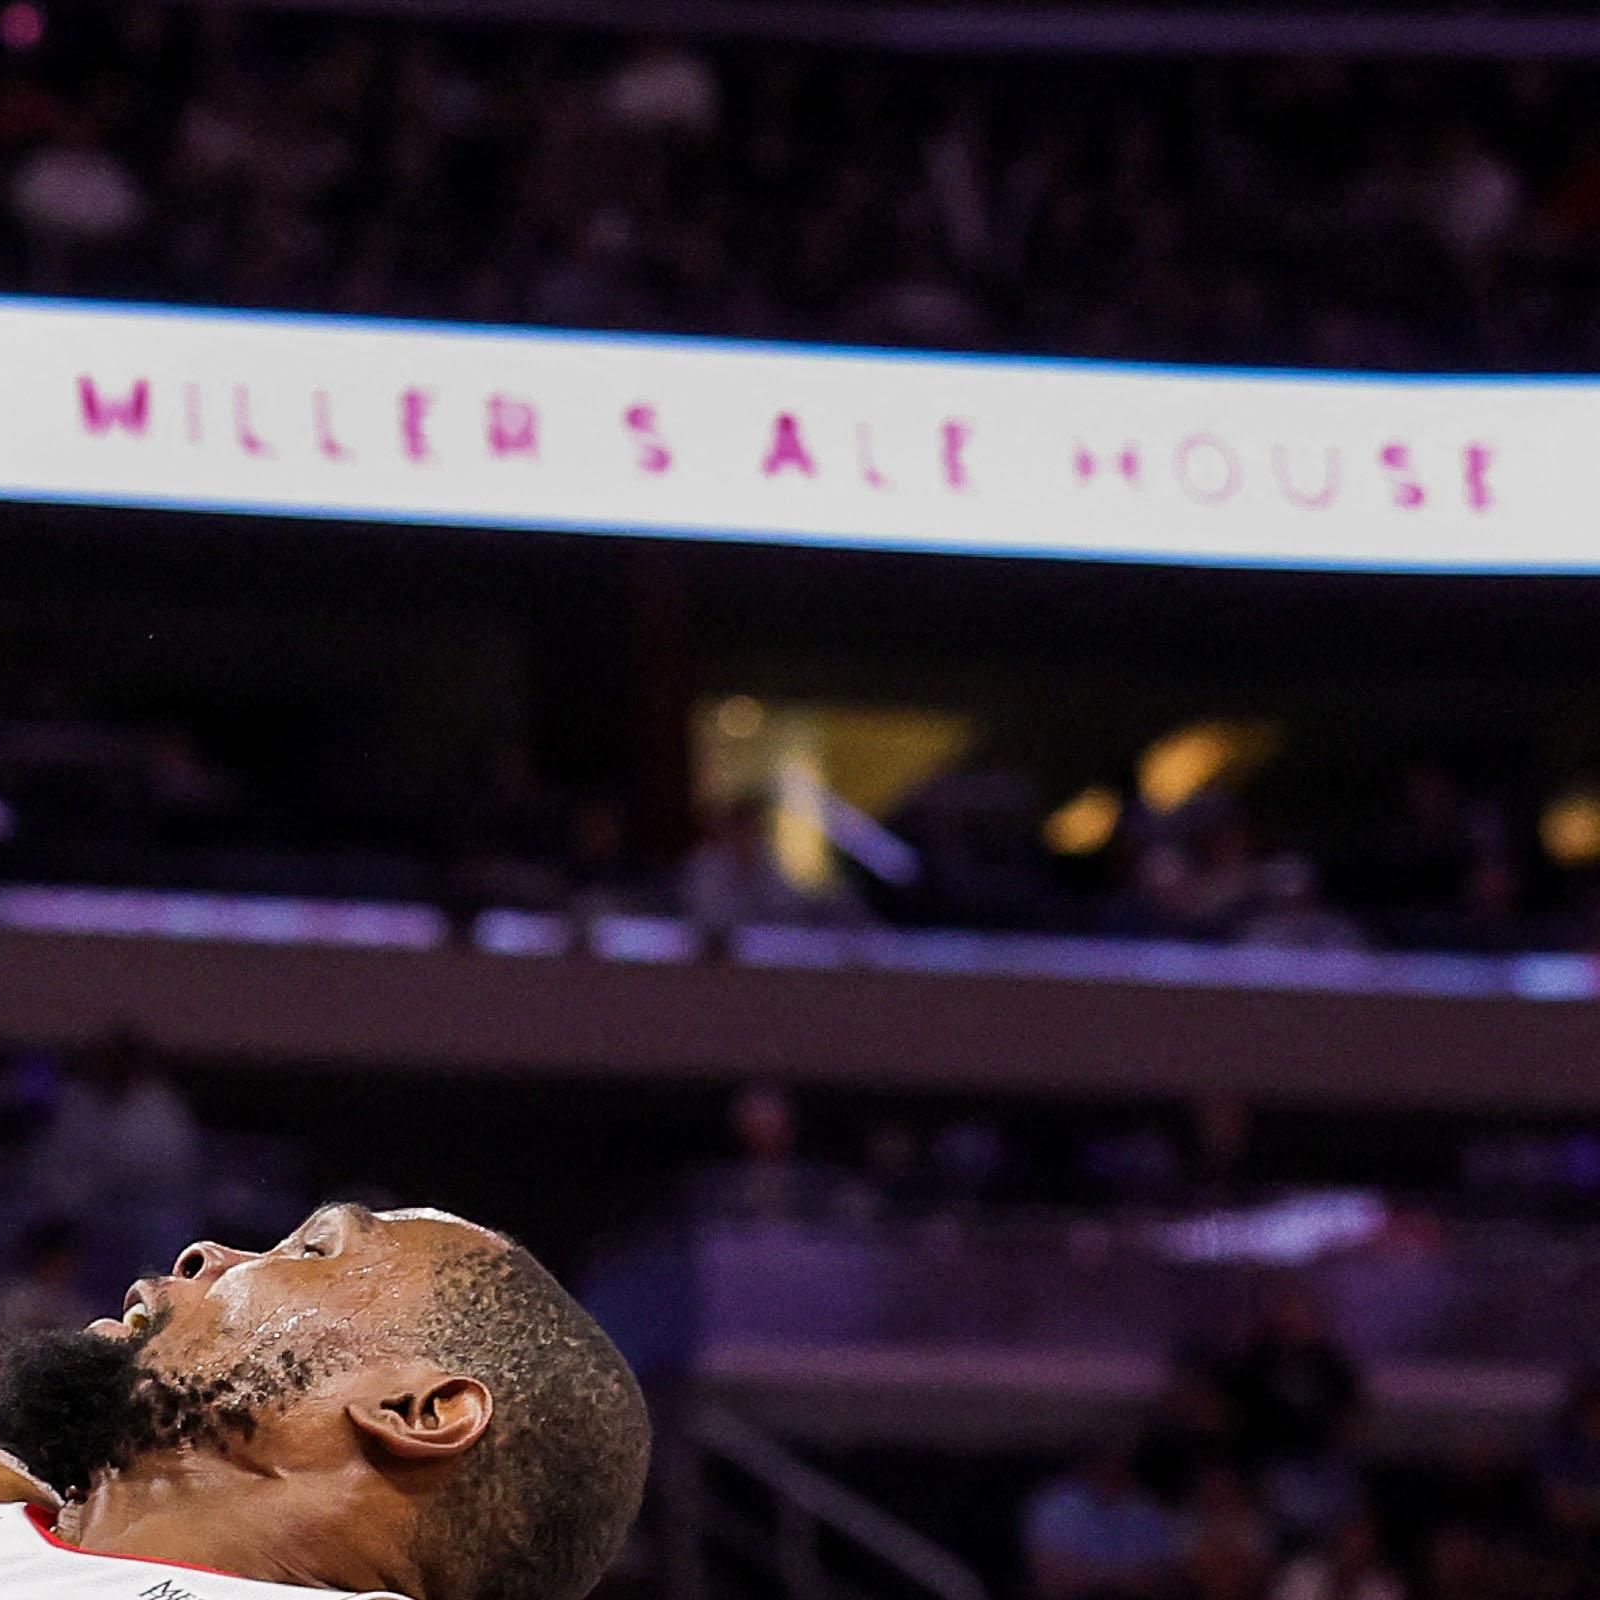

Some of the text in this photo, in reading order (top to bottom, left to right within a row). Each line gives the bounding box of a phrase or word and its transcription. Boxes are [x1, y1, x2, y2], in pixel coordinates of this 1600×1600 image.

[74, 374, 540, 465] MILLER
[761, 410, 978, 492] ALE
[1070, 436, 1500, 514] HOUSE
